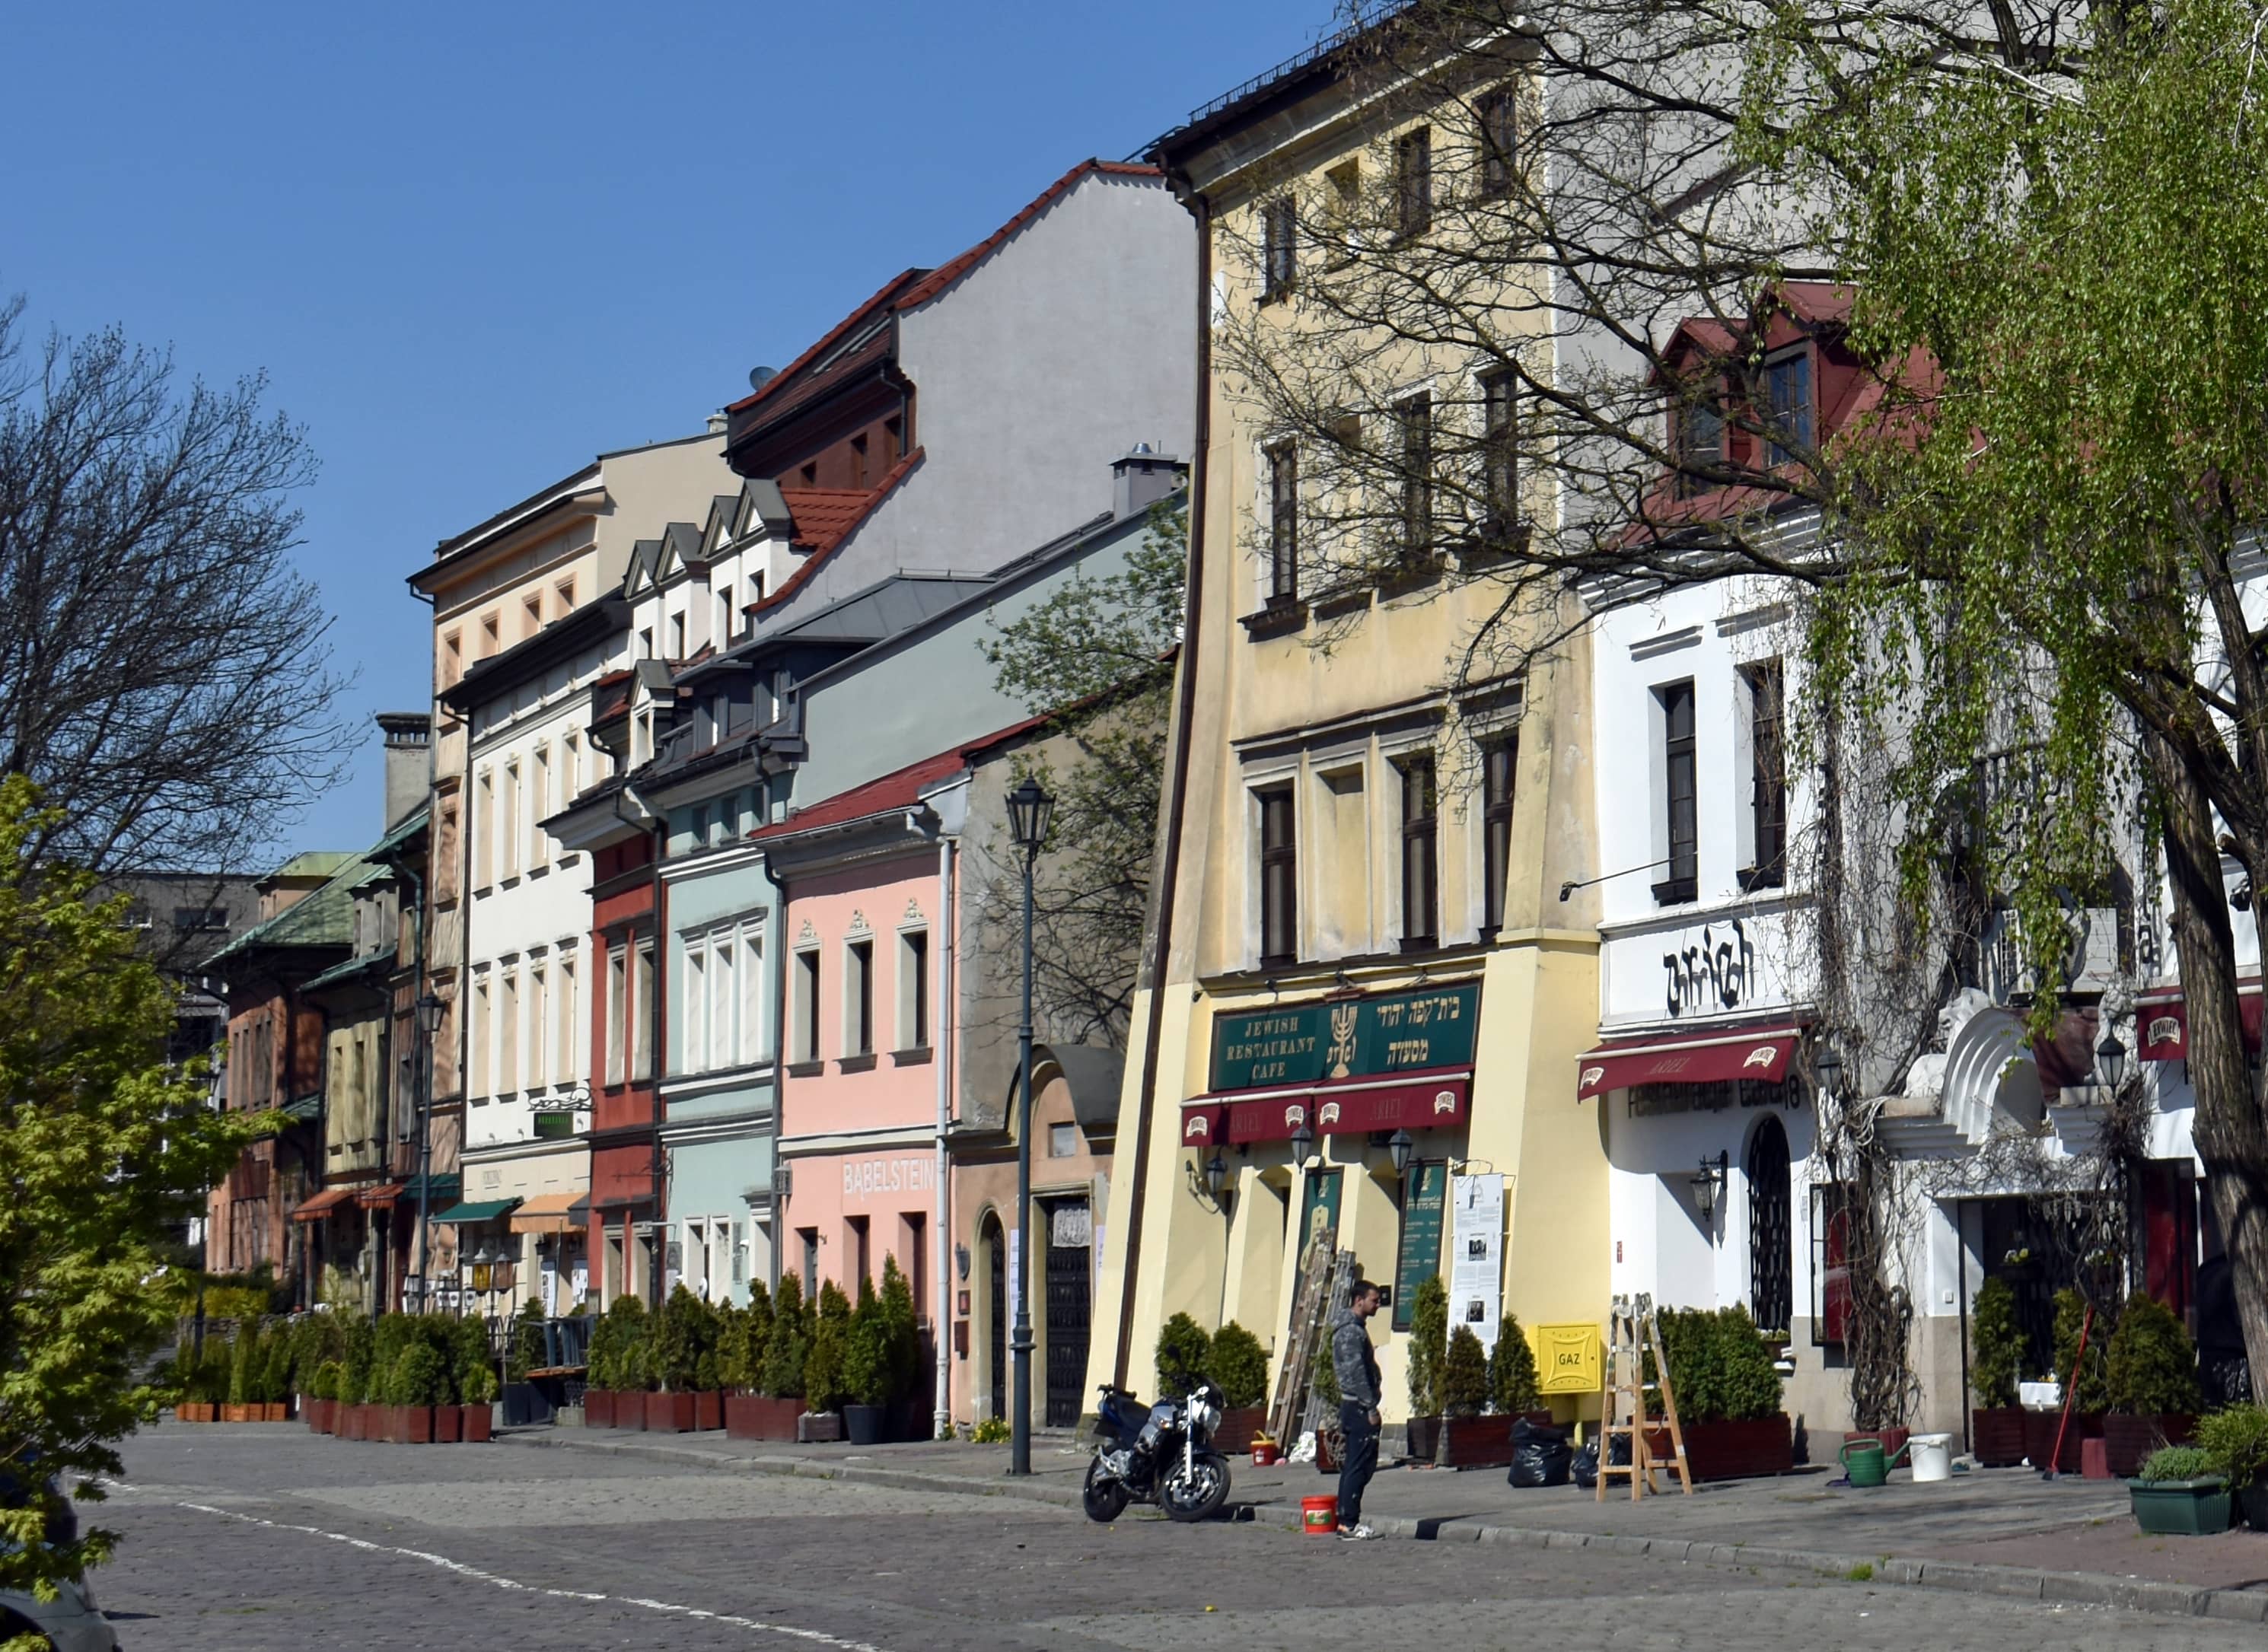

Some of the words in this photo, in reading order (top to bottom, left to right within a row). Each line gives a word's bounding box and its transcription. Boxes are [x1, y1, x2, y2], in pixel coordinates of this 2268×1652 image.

[1244, 1017, 1299, 1037] JEWISH
[1226, 1037, 1316, 1061] RESTAURANT
[1252, 1062, 1285, 1080] CAFE
[1559, 1353, 1580, 1365] GAZ
